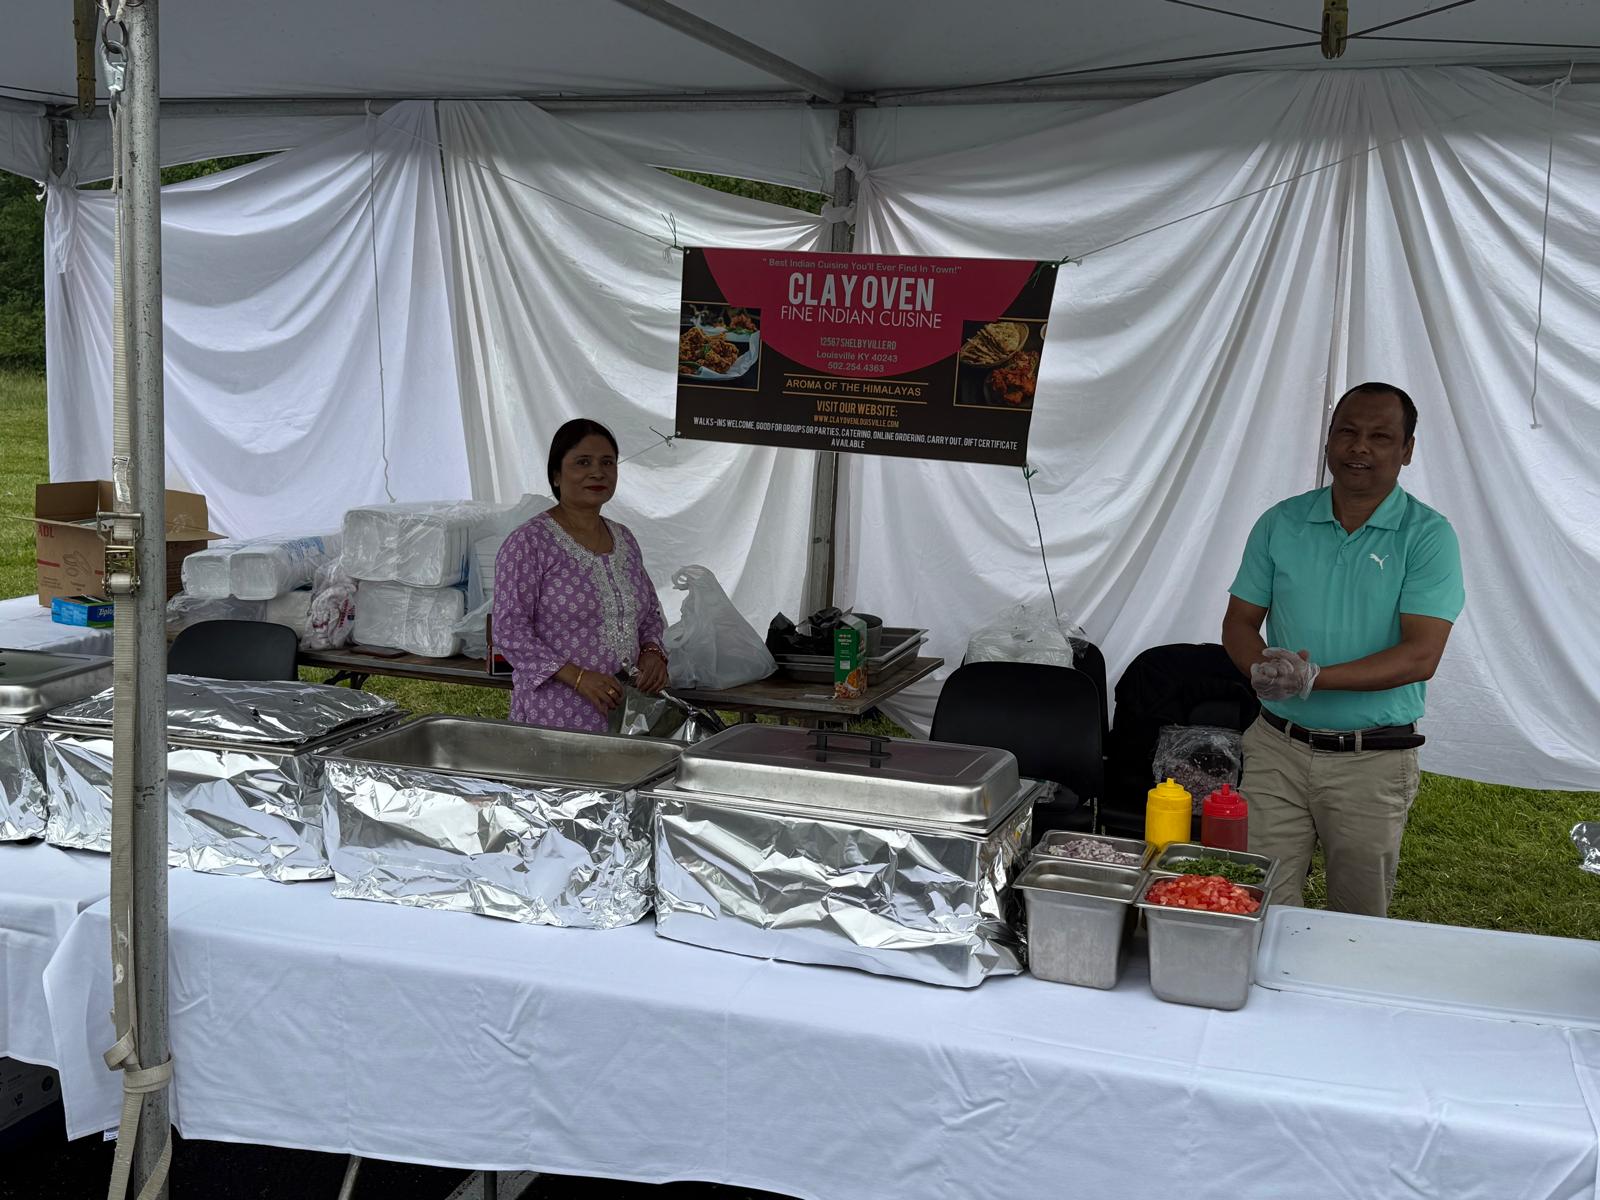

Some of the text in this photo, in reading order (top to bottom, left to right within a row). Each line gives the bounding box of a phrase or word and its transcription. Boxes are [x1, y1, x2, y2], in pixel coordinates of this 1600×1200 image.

[768, 258, 788, 267] Best
[790, 260, 816, 269] Indian
[818, 260, 849, 270] Cuisine
[851, 262, 874, 271] You'll
[876, 263, 895, 272] Ever
[898, 264, 917, 273] Find
[919, 265, 928, 273] In
[788, 272, 935, 312] CLAY OVEN
[780, 306, 942, 329] FINE INDIAN CUISINE
[816, 350, 898, 363] Louisville KY 40243
[785, 379, 921, 397] AROMA OF THE HIMALAYAS
[816, 400, 898, 417] VISIT OUR WEBSITE:
[693, 416, 726, 427] WALKS-INS
[756, 421, 771, 431] GOOD
[771, 422, 783, 431] FOR
[783, 423, 805, 434] GROUPS
[806, 425, 814, 434] OR
[873, 431, 895, 441] ONLINE
[927, 435, 950, 445] CARRY
[964, 437, 978, 447] GIFT
[978, 438, 1018, 450] CERTIFICATE
[831, 438, 865, 449] AVAILABLE
